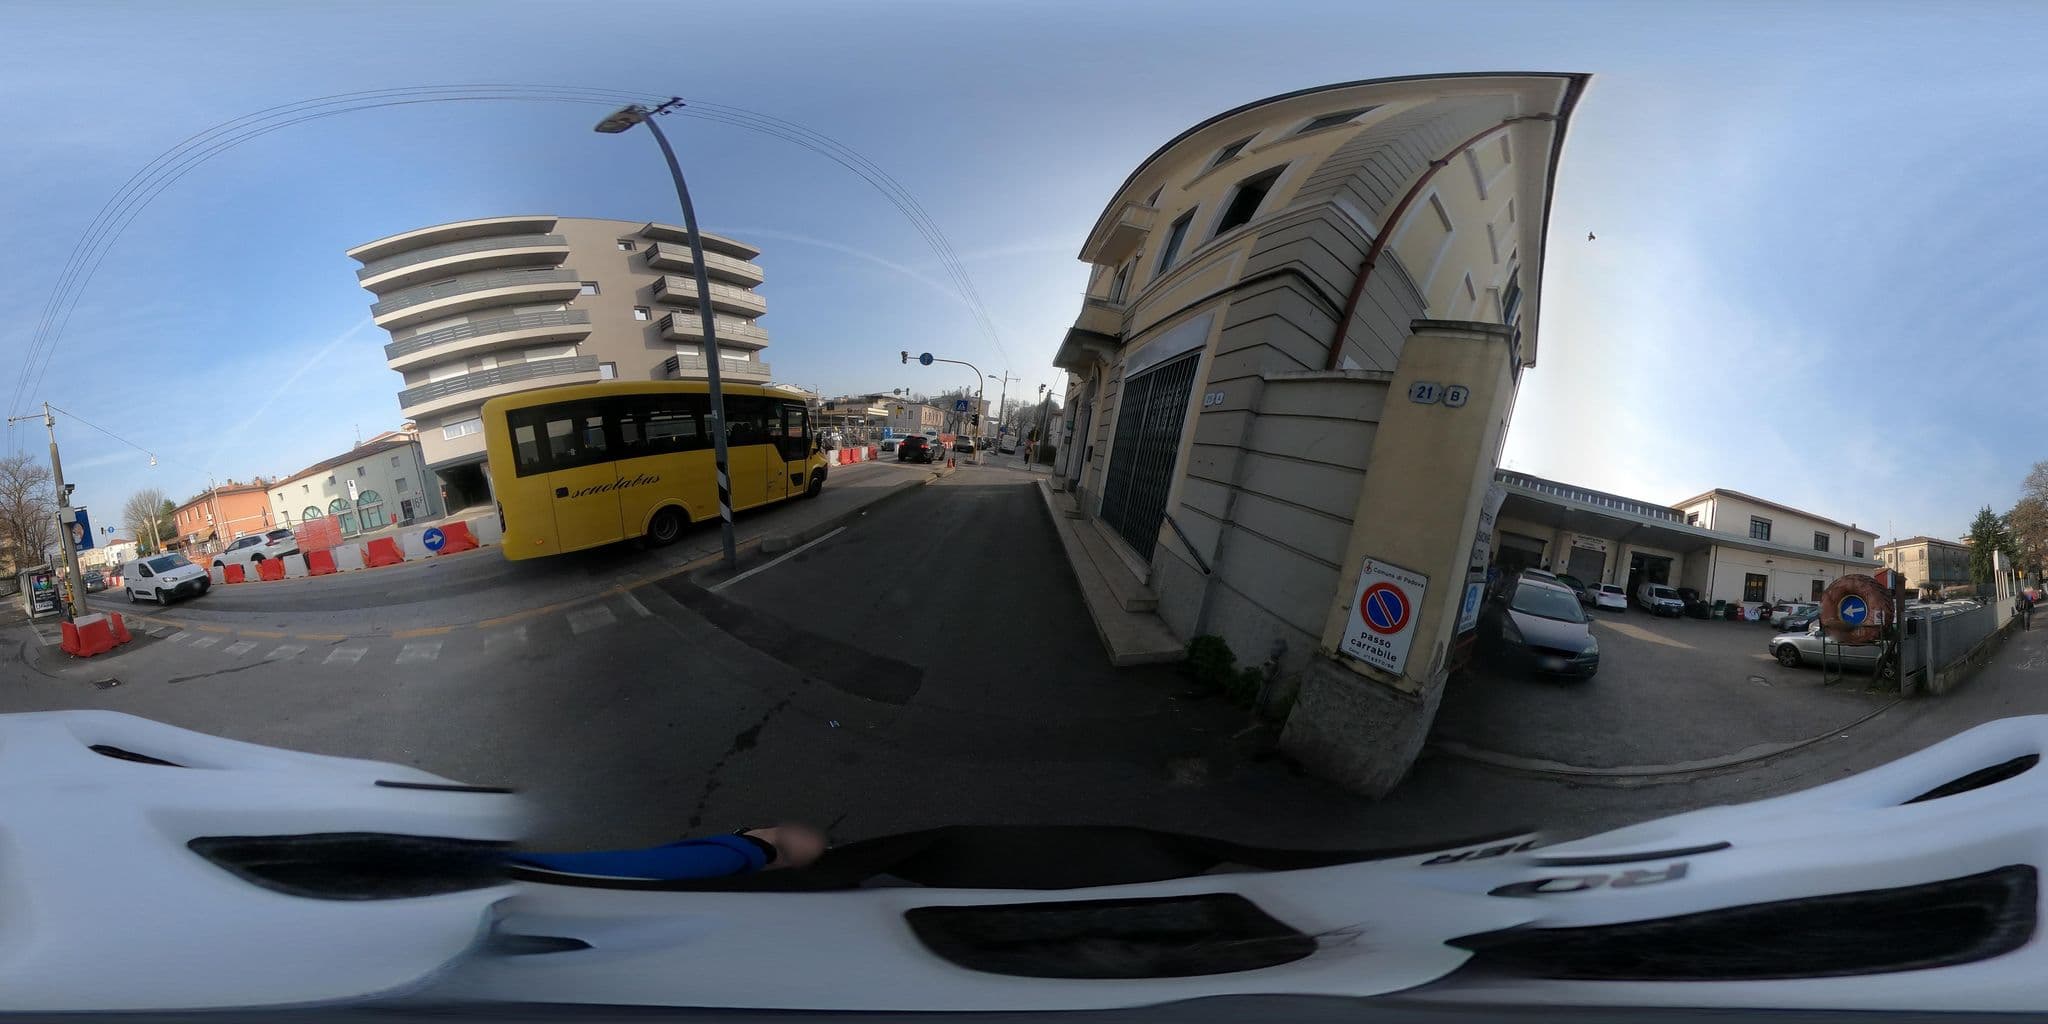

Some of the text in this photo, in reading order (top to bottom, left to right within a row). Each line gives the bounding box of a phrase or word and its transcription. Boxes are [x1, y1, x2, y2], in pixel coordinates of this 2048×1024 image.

[1416, 385, 1460, 401] 21 B
[571, 473, 660, 498] scuolabus
[1373, 567, 1395, 579] Comune
[1403, 576, 1424, 588] Padova
[1350, 638, 1397, 662] carrabile
[1361, 632, 1391, 649] passo
